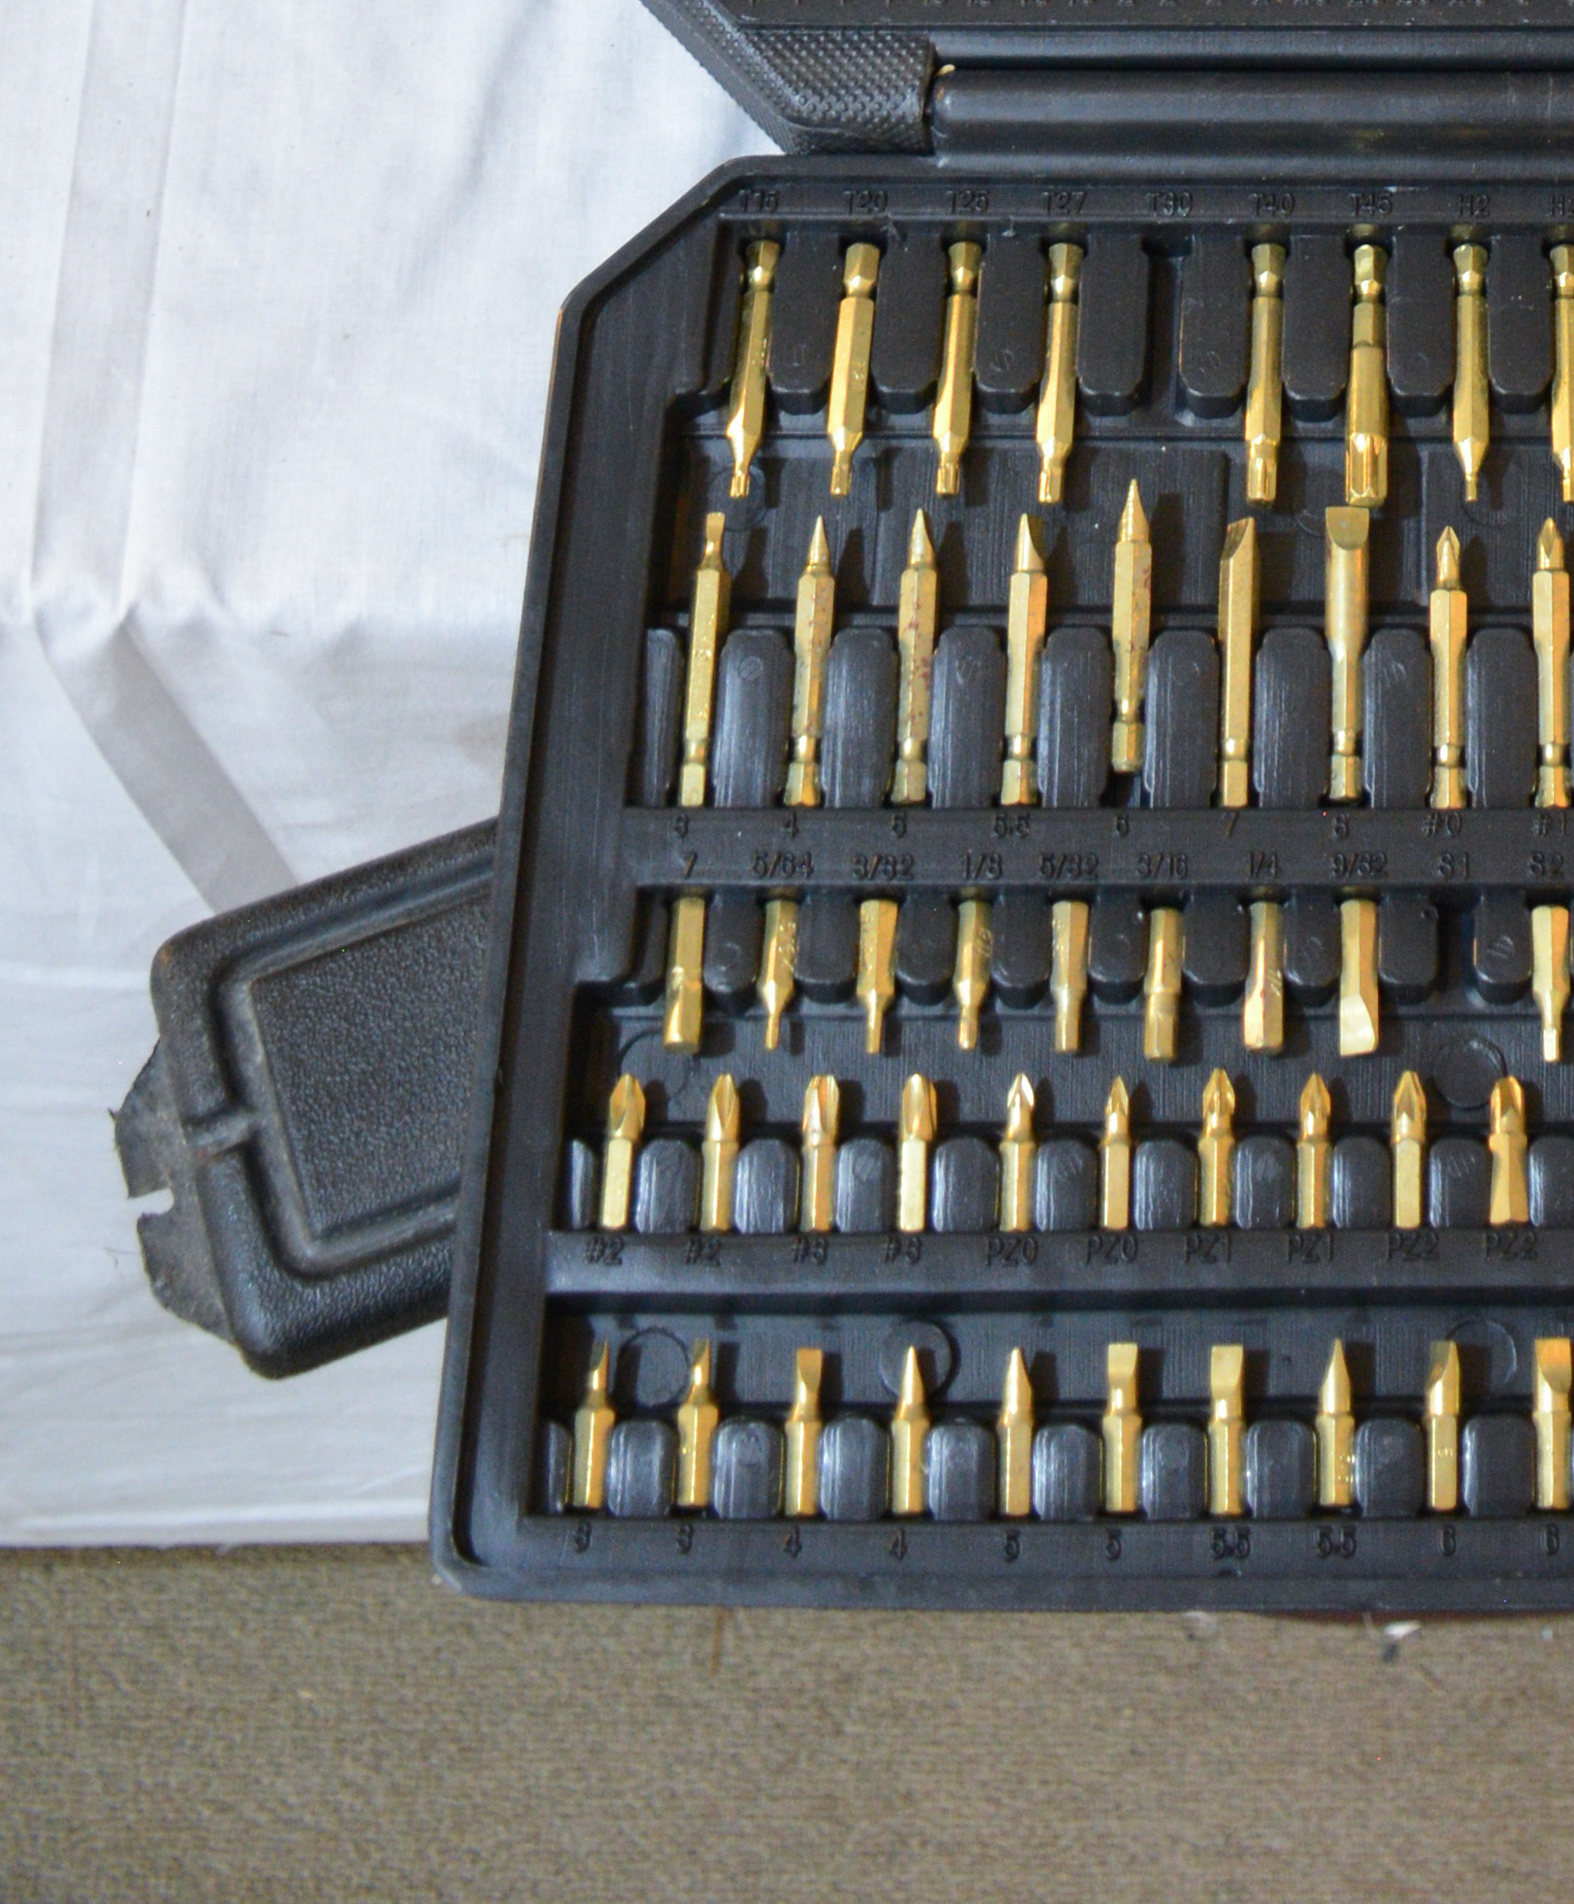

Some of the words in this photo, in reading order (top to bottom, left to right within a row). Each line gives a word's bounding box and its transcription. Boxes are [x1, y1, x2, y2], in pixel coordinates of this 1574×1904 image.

[739, 188, 779, 214] T15
[844, 188, 888, 214] T20
[947, 188, 990, 214] T25
[1042, 188, 1088, 214] T27
[1145, 190, 1194, 218] T30
[1250, 191, 1296, 217] T40
[1349, 191, 1395, 217] T45
[1455, 192, 1491, 218] H2
[783, 812, 799, 837] 4
[892, 813, 908, 838] 5
[992, 812, 1031, 838] 5.5
[1113, 813, 1130, 839] 6
[1224, 812, 1240, 838] 7
[1423, 811, 1463, 838] #0
[1532, 814, 1568, 836] #1
[680, 850, 698, 880] 7
[752, 850, 815, 880] 5/64
[852, 853, 916, 880] 3/32
[961, 853, 1004, 880] 1/8
[1039, 853, 1099, 879] 5/32
[1136, 853, 1189, 879] 3/16
[1247, 851, 1280, 879] 1/4
[1331, 852, 1389, 879] 9/32
[584, 1236, 625, 1267] #2
[684, 1236, 722, 1267] #2
[985, 1235, 1040, 1268] PZ0
[1085, 1234, 1139, 1267] PZ0
[1183, 1233, 1232, 1265] PZ1
[1286, 1233, 1335, 1265] PZ1
[1386, 1230, 1440, 1261] PZ2
[1484, 1229, 1539, 1261] PZ2
[783, 1526, 802, 1559] 4
[888, 1527, 908, 1561] 4
[1004, 1529, 1020, 1564] 5
[1105, 1528, 1122, 1561] 5
[1210, 1526, 1251, 1560] 5.5
[1316, 1525, 1357, 1558] 5.5
[1439, 1526, 1457, 1557] 6
[1543, 1525, 1560, 1556] 6
